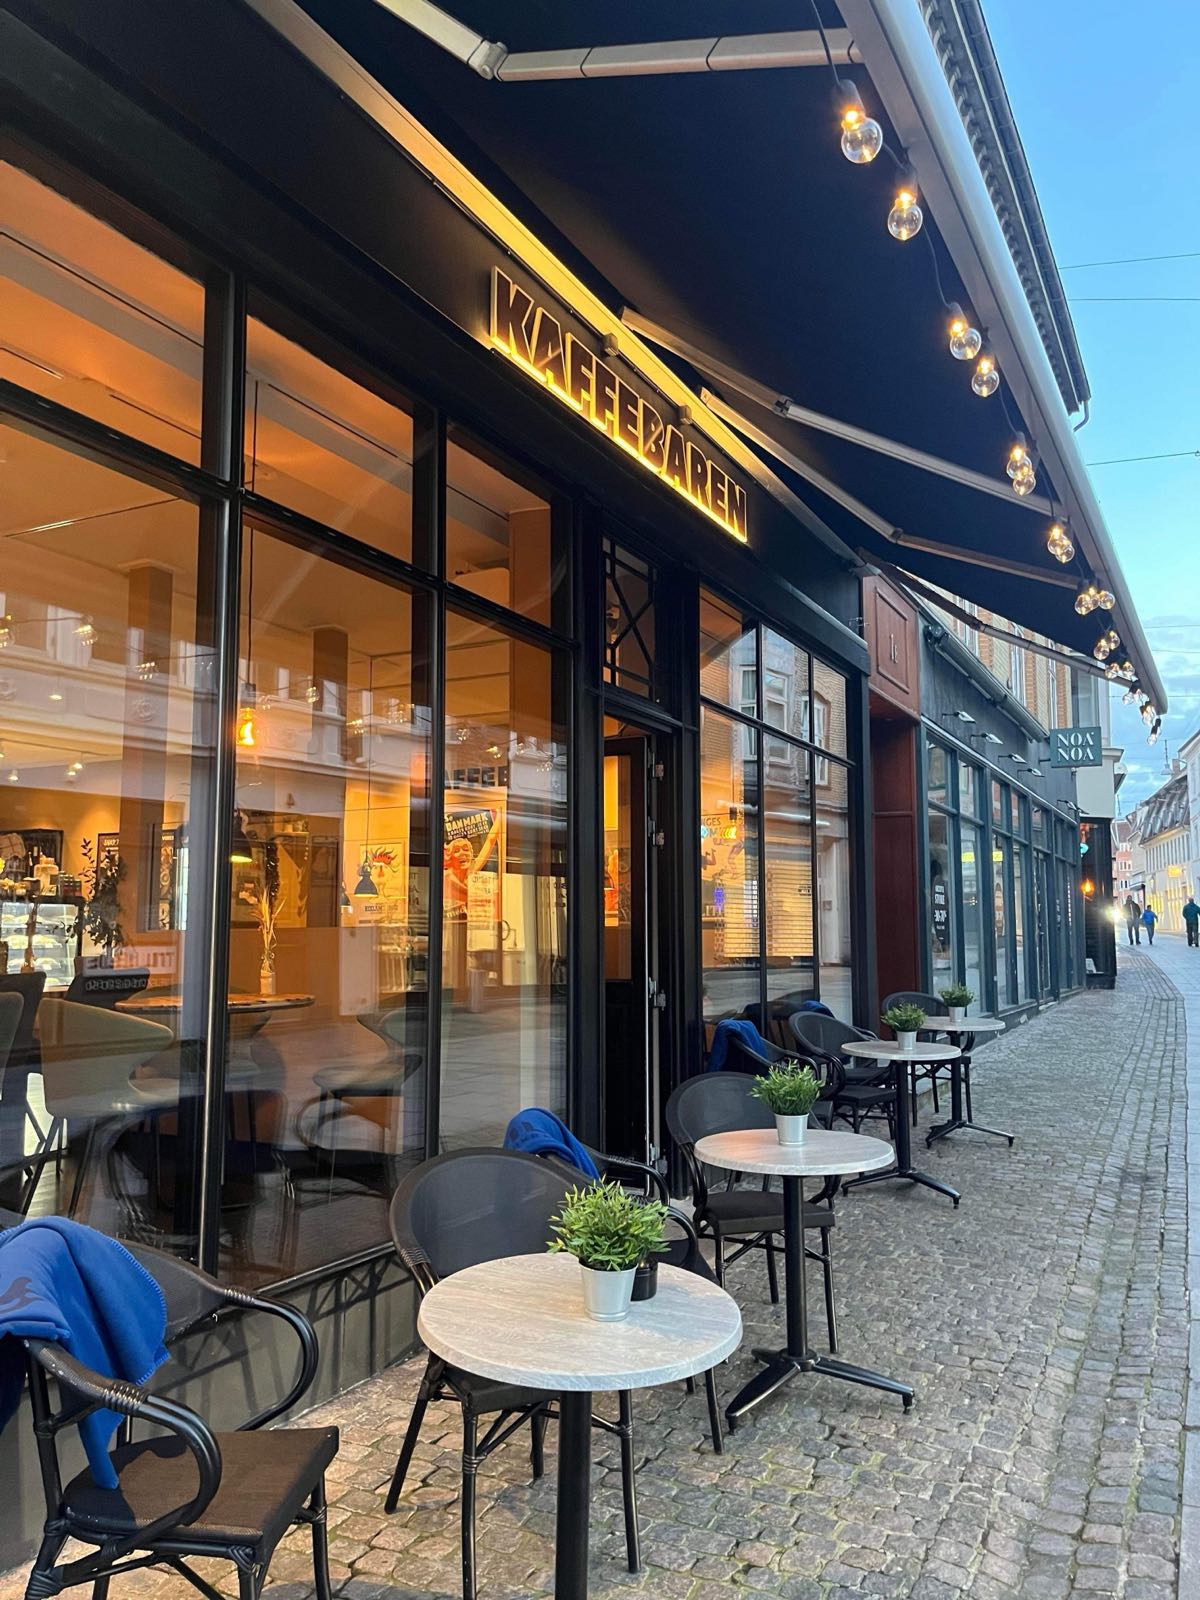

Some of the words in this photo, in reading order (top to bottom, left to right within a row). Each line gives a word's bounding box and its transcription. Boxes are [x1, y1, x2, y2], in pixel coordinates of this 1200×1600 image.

[490, 265, 747, 543] KAFFEBAREN
[1057, 732, 1094, 747] NOA
[1057, 747, 1095, 761] NOA
